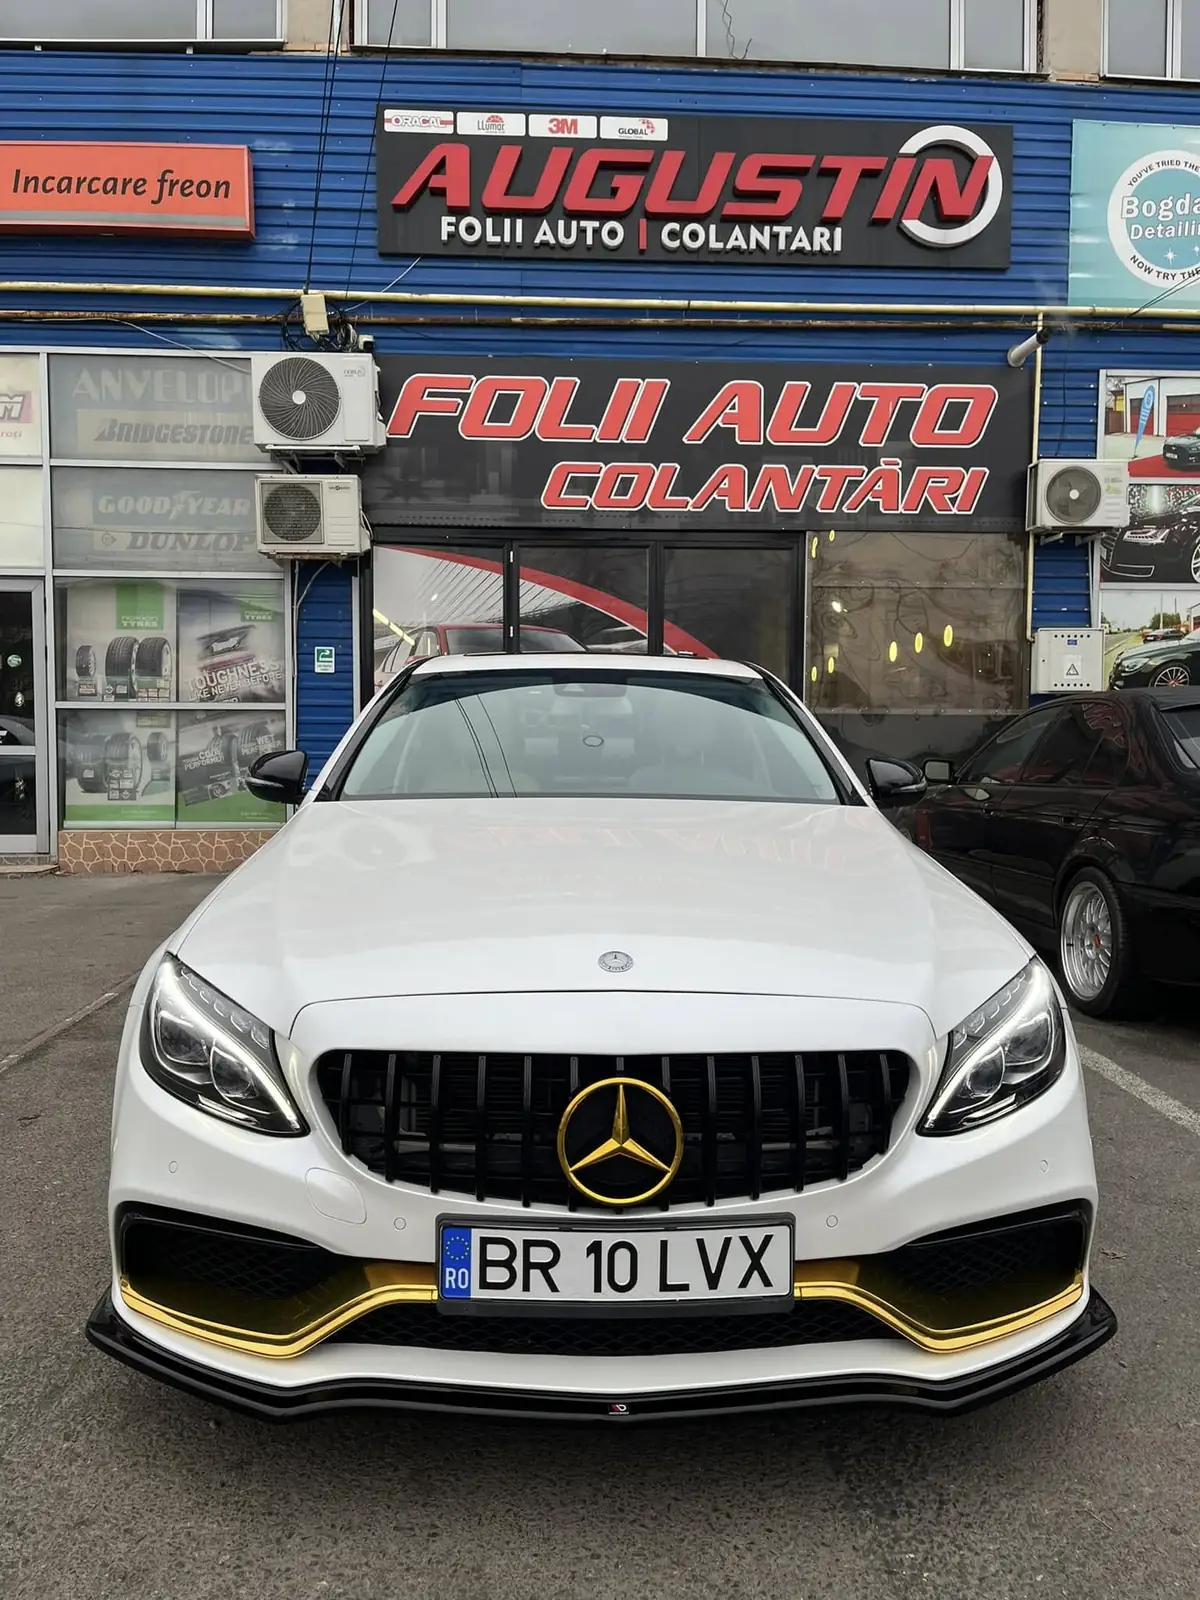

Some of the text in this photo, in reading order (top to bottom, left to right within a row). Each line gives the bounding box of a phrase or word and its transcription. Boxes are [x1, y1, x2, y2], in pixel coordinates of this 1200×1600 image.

[391, 114, 447, 128] ORACAL
[548, 117, 578, 135] 3M
[618, 127, 648, 136] GLOBAL
[12, 168, 231, 205] Incarcare freon
[391, 143, 995, 222] AUGUSTIN
[1127, 164, 1154, 188] YOU'VE
[1155, 160, 1181, 169] TRIED
[441, 215, 842, 253] FOLII AUTO COLANTARI
[1130, 255, 1153, 275] NOW
[1155, 270, 1177, 280] TRY
[387, 373, 999, 448] FOLII AUTO
[94, 418, 253, 445] BRIDGESTONE
[126, 532, 256, 552] DUNLOP
[187, 656, 281, 692] TOUGHNESS
[479, 1234, 775, 1294] BR 10 LVX
[445, 1267, 469, 1289] RO
